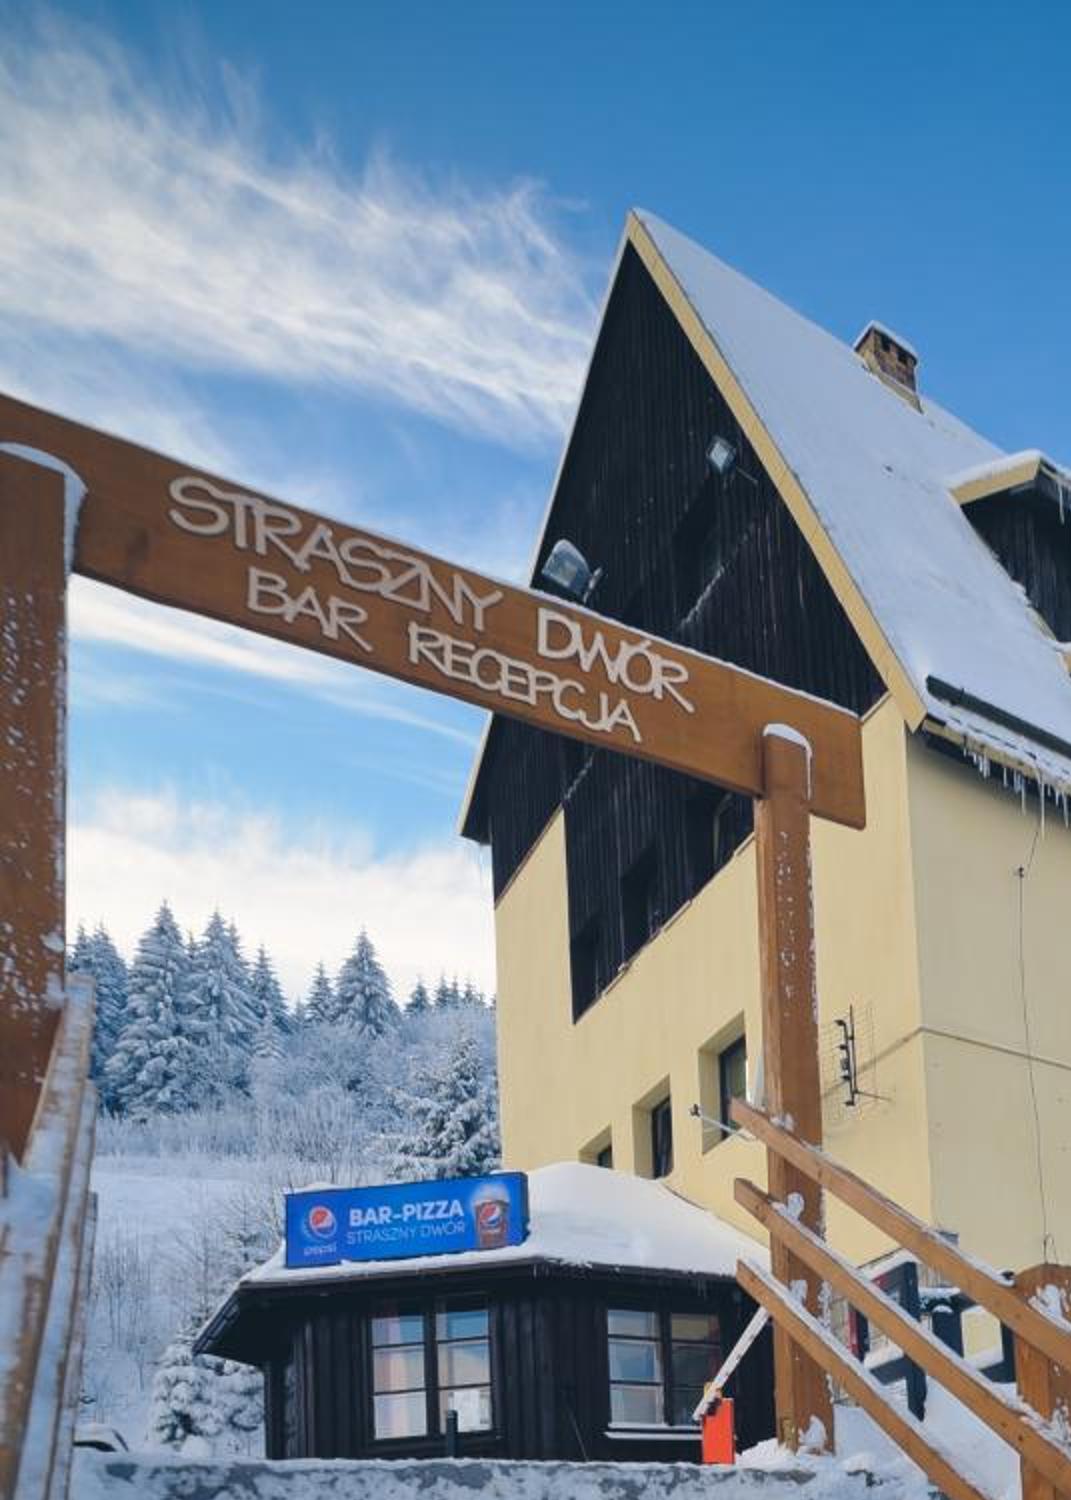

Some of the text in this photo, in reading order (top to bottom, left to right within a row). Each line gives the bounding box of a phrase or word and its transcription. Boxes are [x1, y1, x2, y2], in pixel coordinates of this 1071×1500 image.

[168, 476, 695, 713] STRASZNY DWÓR
[246, 566, 643, 743] BAR RECEPCJA
[346, 1226, 417, 1246] STRASZNY
[349, 1199, 465, 1227] BAR-PIZZA
